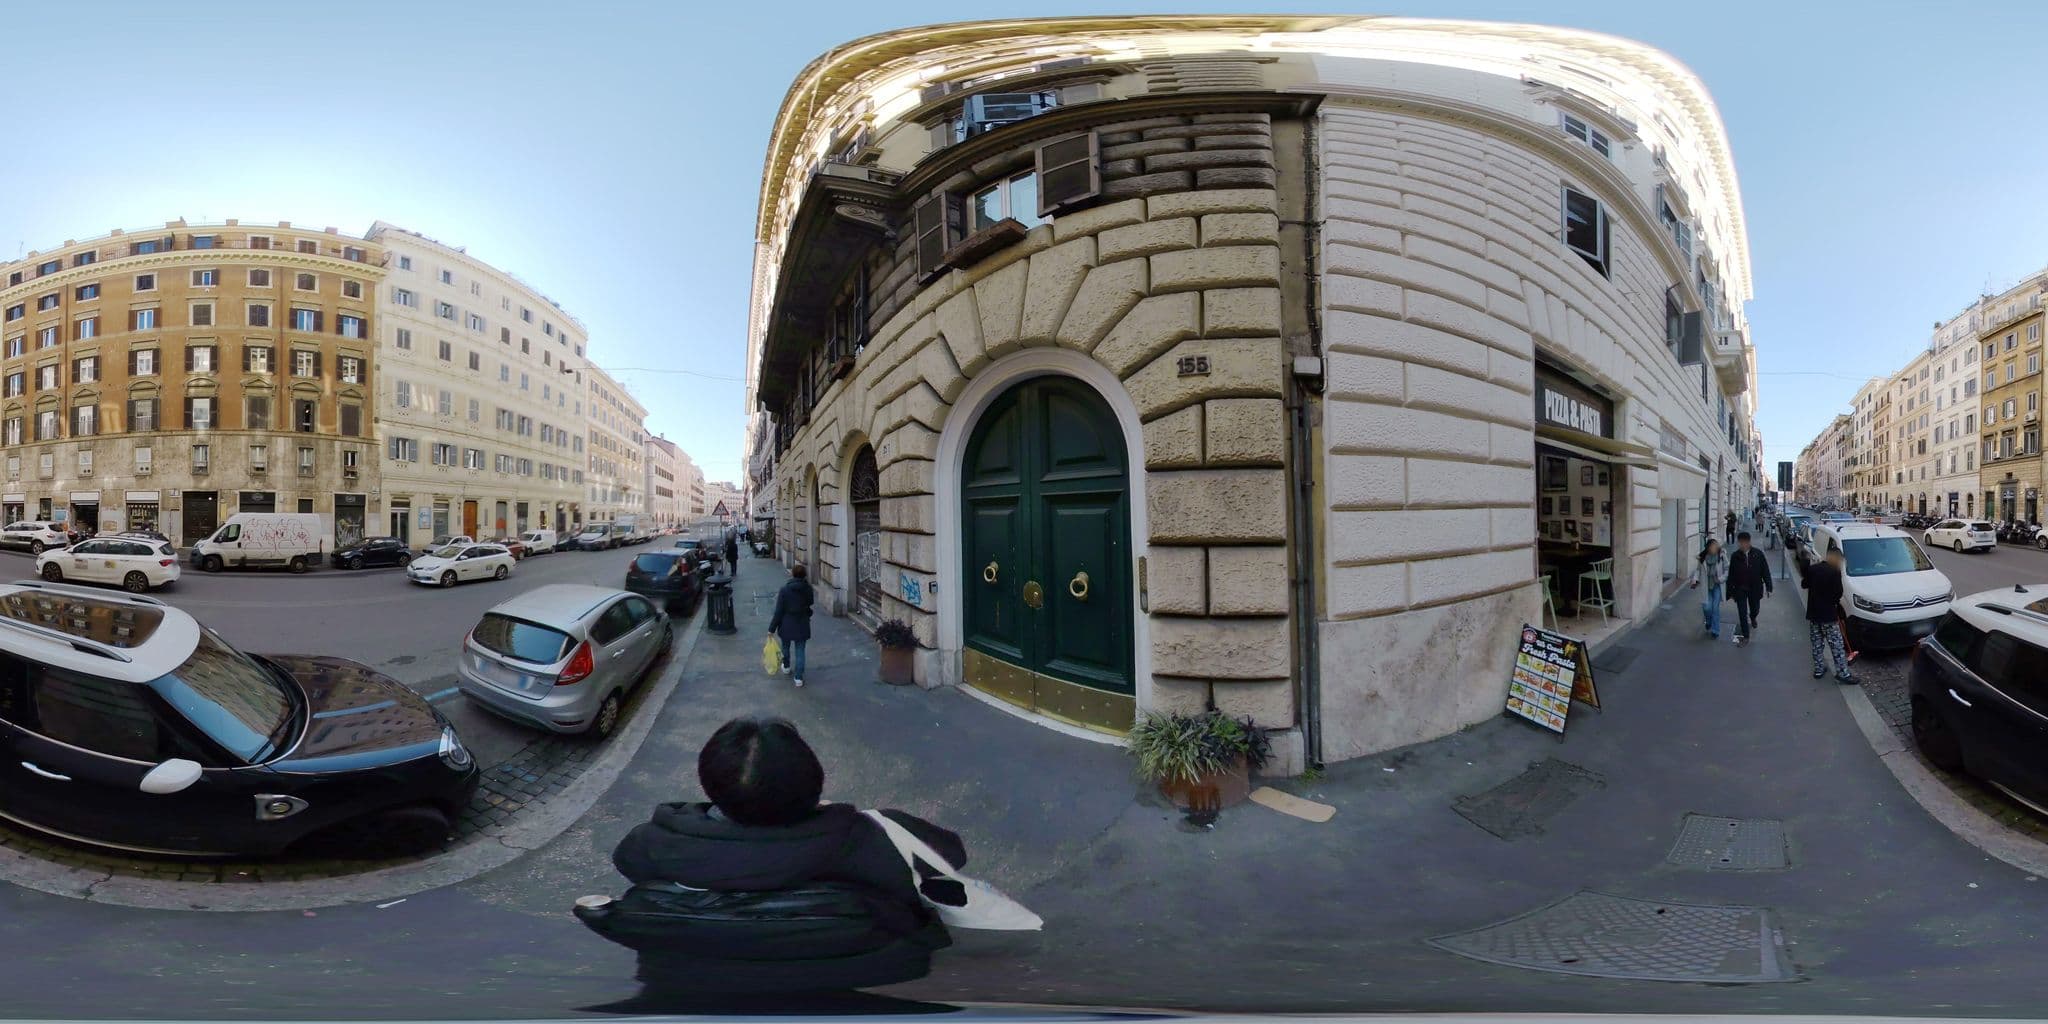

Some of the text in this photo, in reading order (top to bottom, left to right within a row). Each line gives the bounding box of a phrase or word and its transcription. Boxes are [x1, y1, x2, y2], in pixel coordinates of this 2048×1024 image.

[1176, 357, 1209, 374] 155
[1545, 388, 1601, 437] PIZZA & PASTA
[1522, 643, 1576, 669] Fresh Pasta
